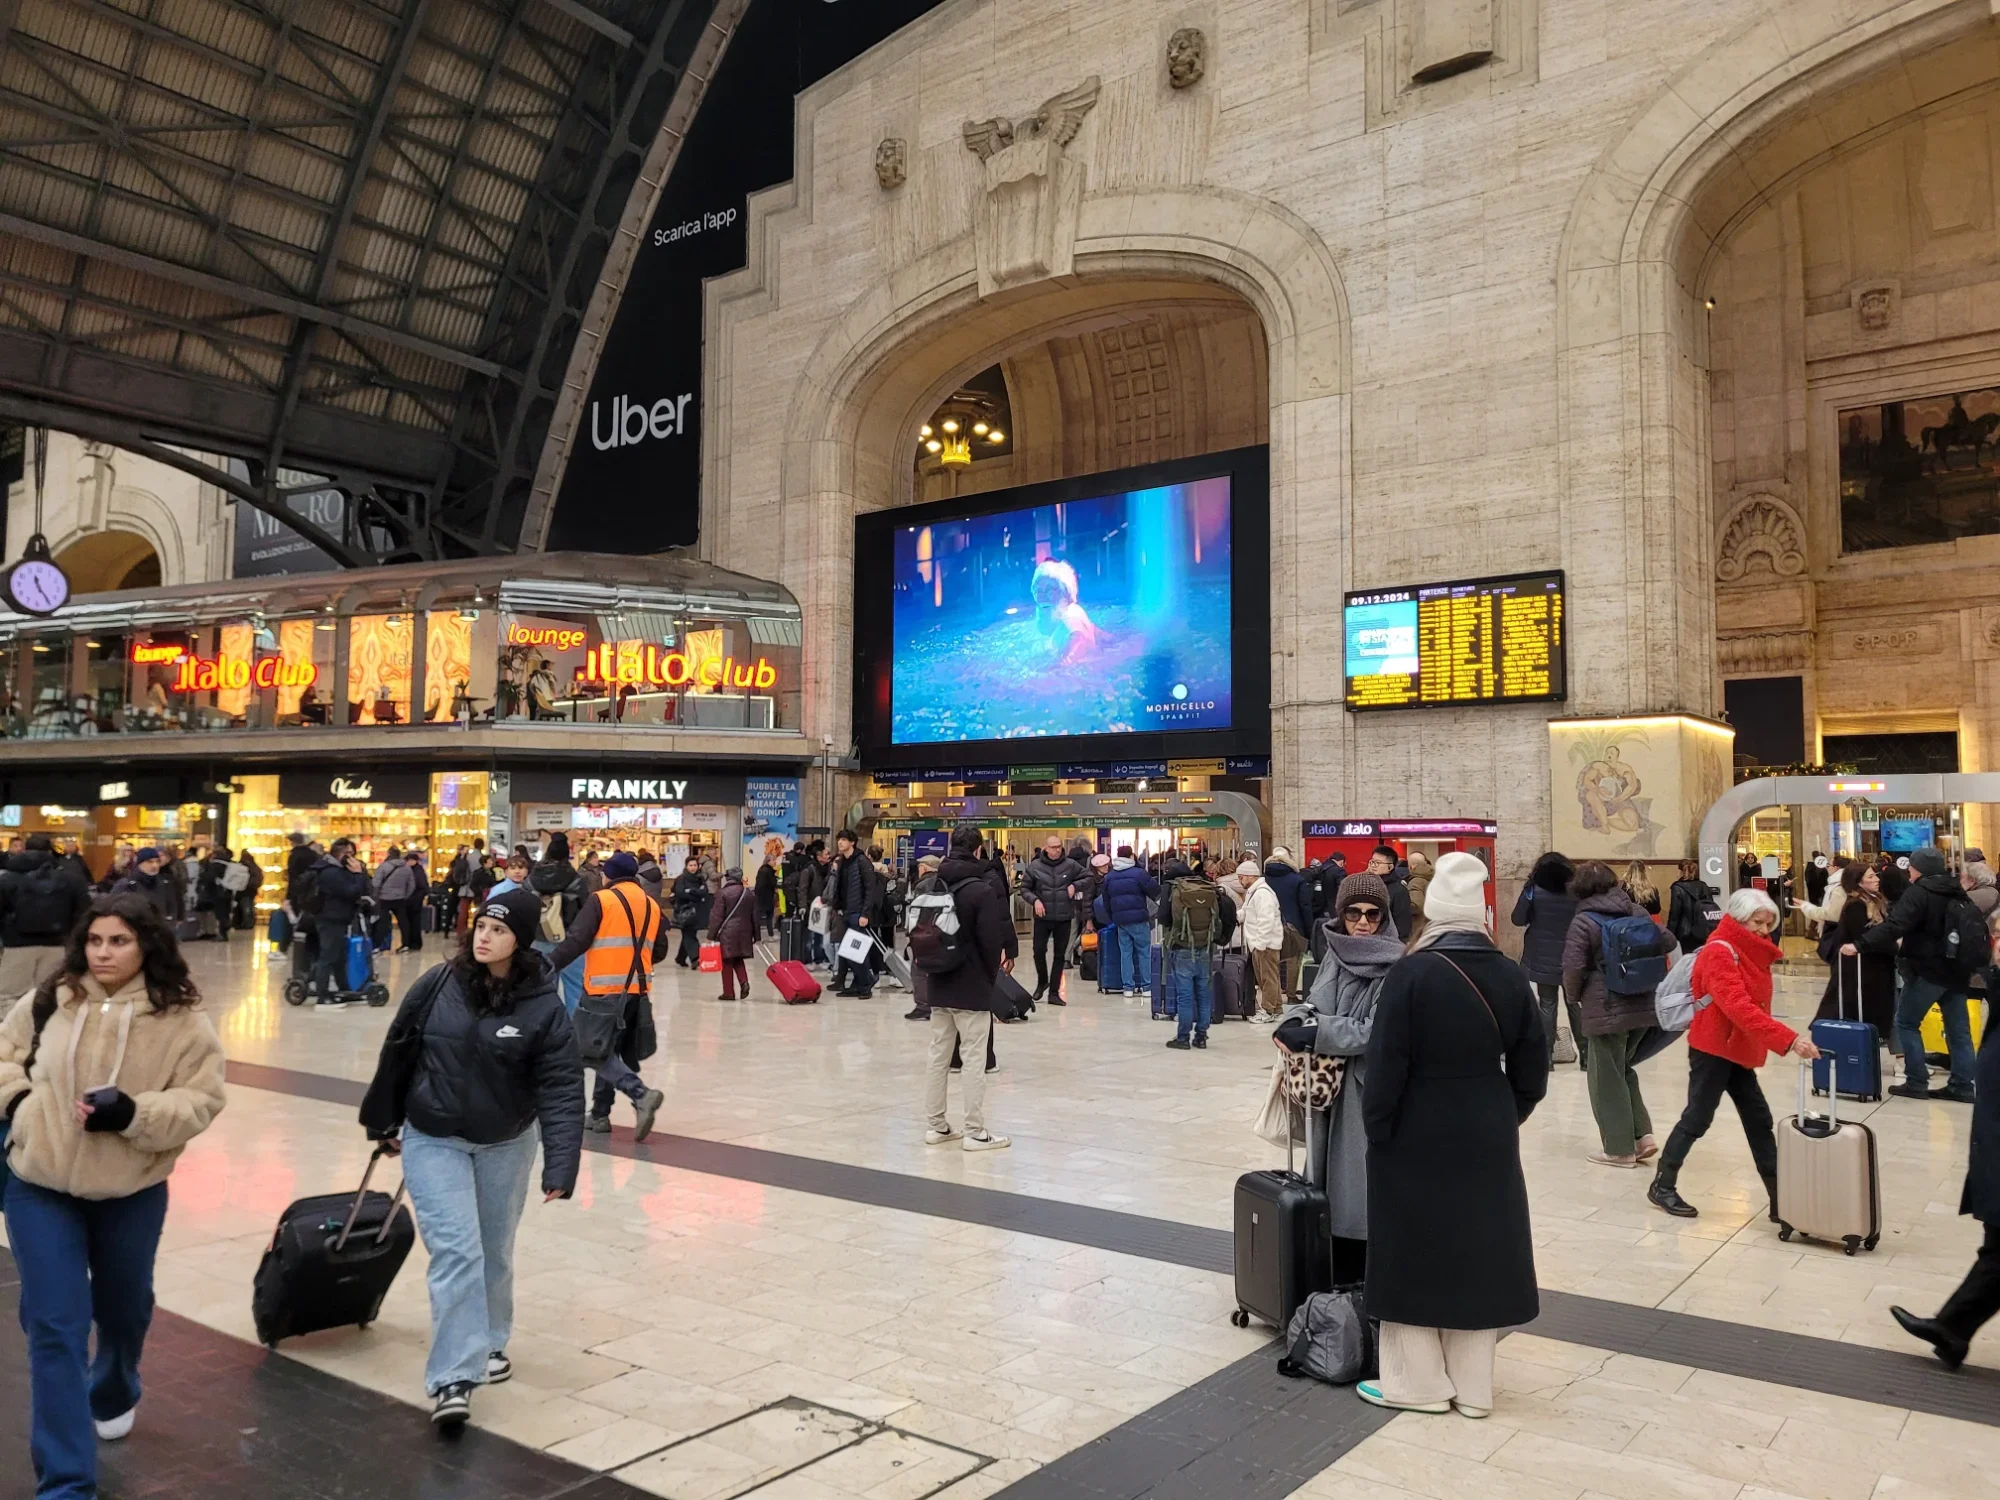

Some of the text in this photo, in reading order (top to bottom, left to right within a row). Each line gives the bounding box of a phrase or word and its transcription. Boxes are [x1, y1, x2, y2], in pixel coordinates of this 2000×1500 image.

[654, 206, 737, 247] Scarica l'app
[591, 392, 692, 451] Uber
[1351, 592, 1410, 605] 09.12.2024
[508, 622, 586, 651] lounge
[133, 644, 184, 665] lounge
[255, 656, 318, 688] Club
[1146, 701, 1215, 713] MONTICELLO
[330, 777, 372, 800] Venchi
[571, 778, 688, 800] FRANKLY
[747, 783, 796, 791] BUBBLE TEA
[1885, 808, 1934, 821] Centrale
[1705, 857, 1723, 875] C
